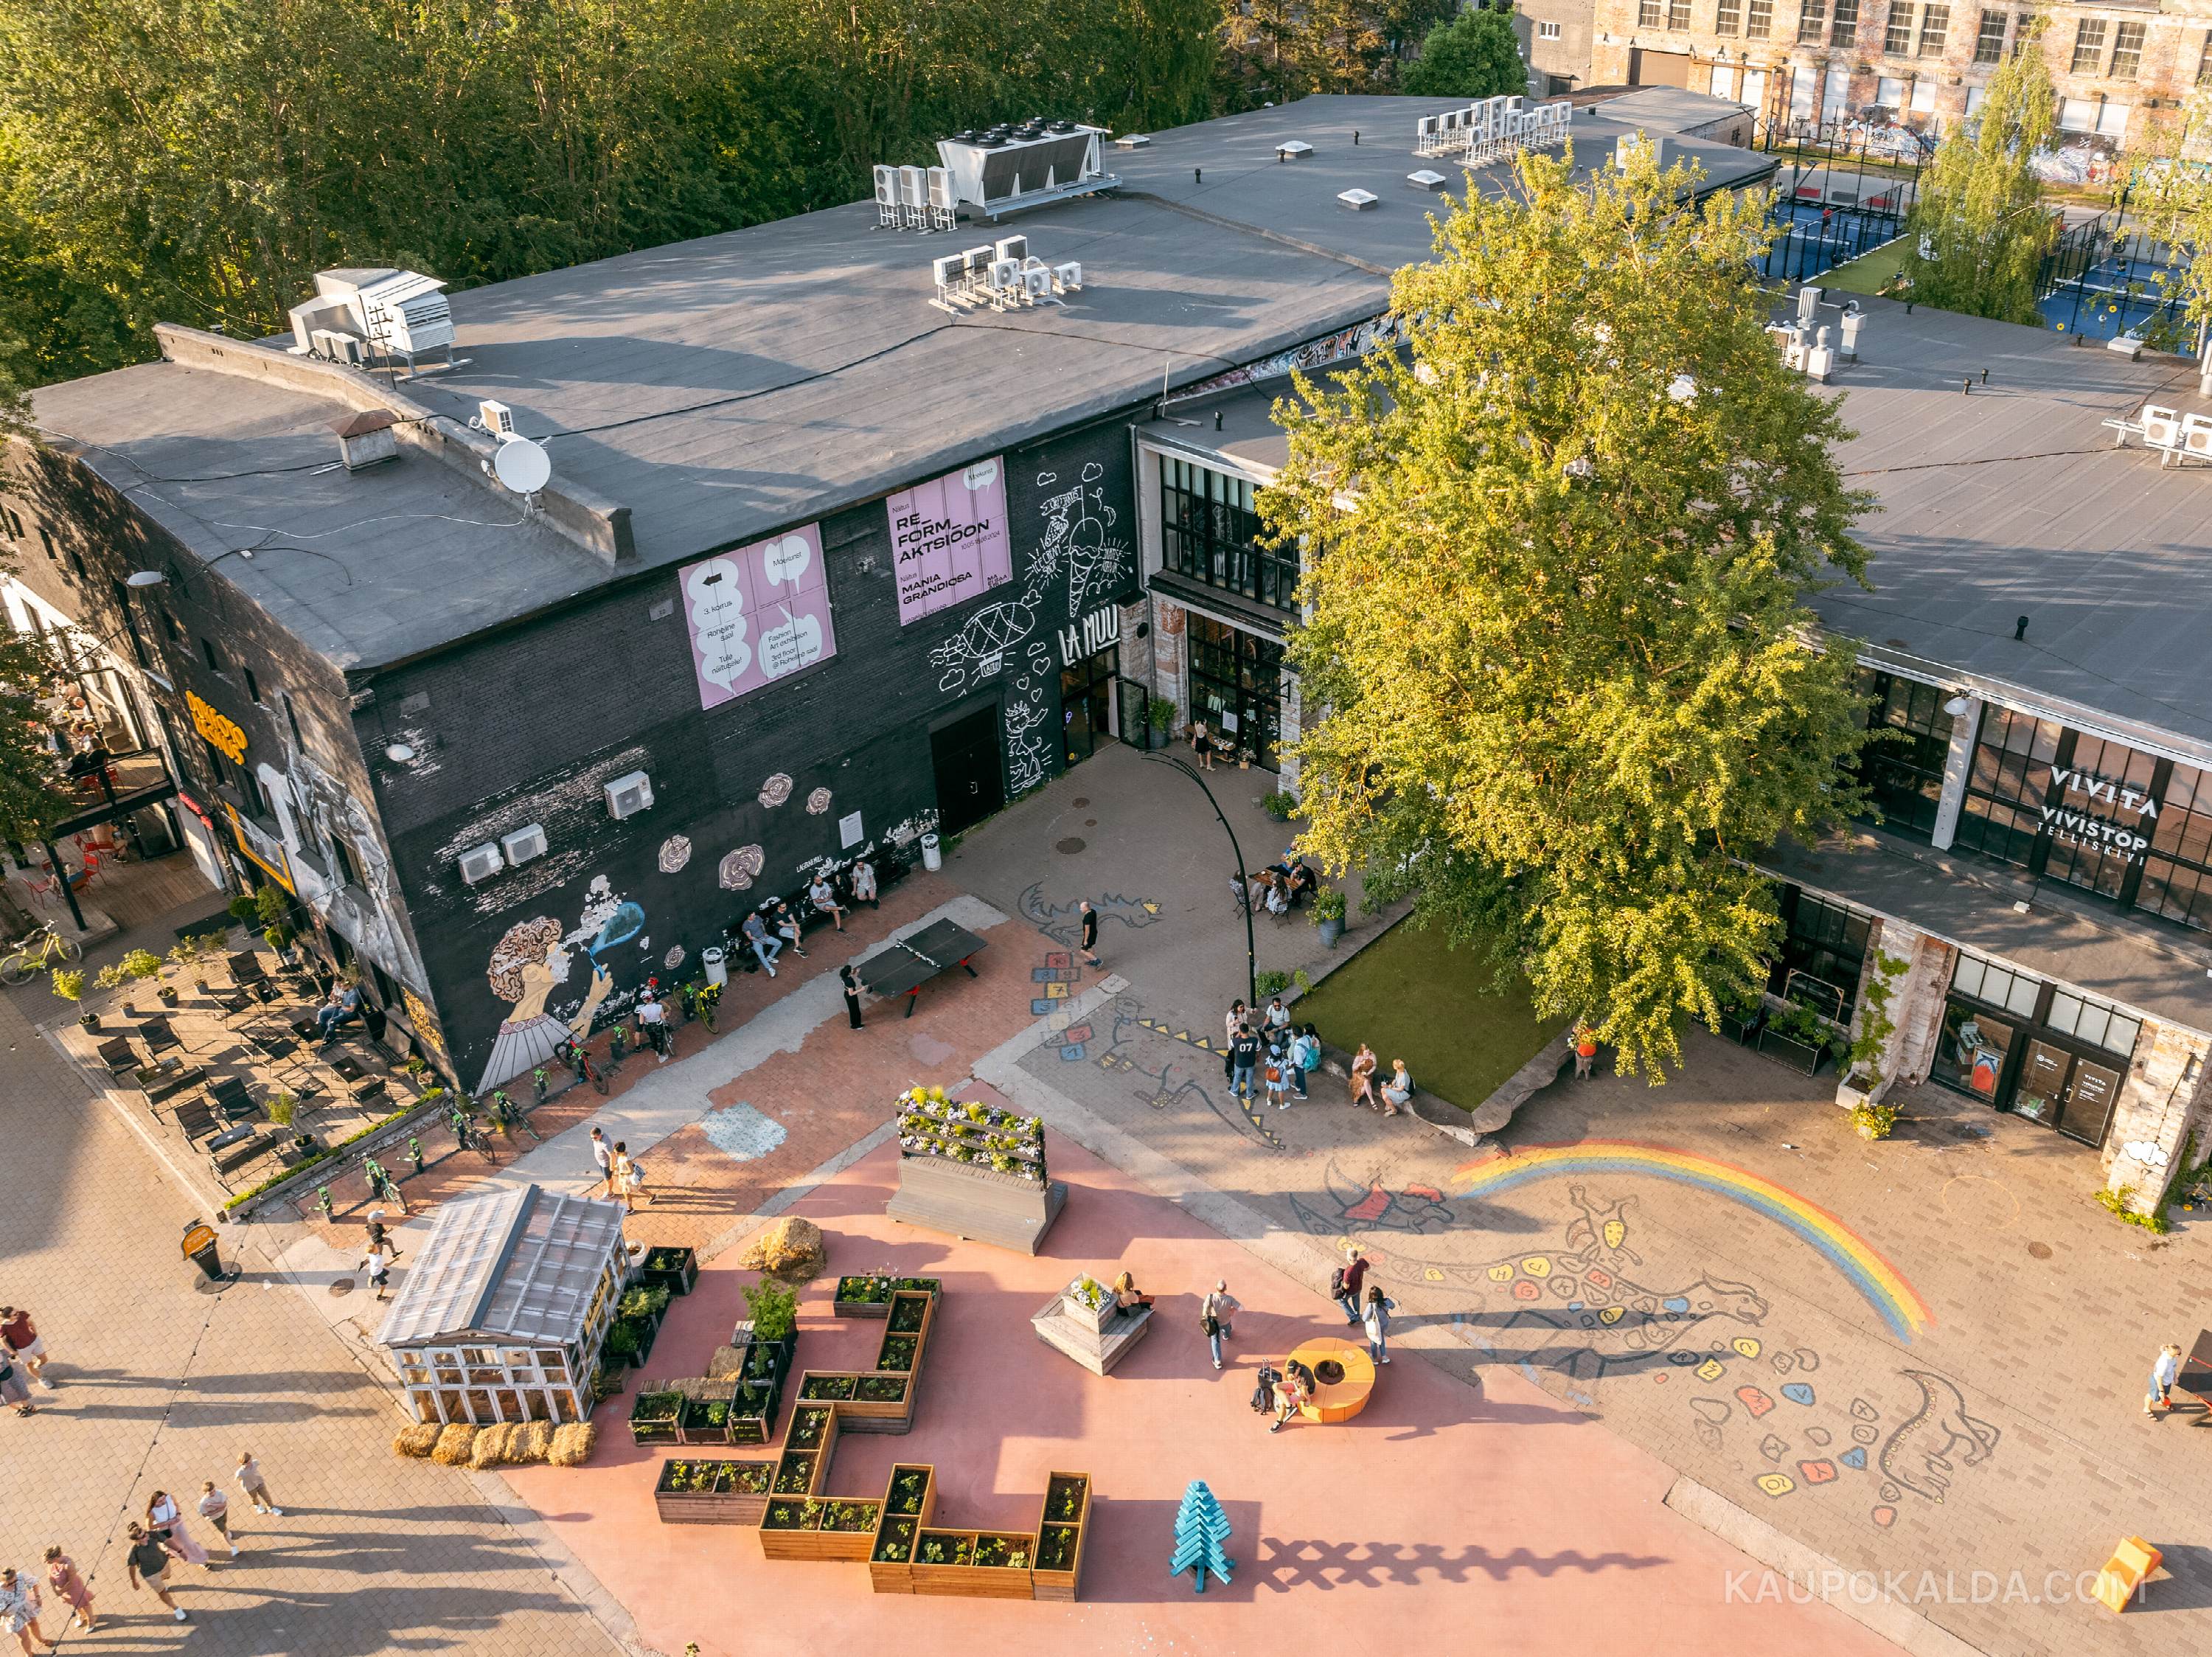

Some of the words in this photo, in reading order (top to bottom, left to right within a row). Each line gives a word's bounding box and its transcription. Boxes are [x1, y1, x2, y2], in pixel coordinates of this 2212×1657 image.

[773, 551, 802, 567] Moekunst
[902, 574, 942, 594] MANIA
[902, 572, 973, 605] GRANDIOSA
[711, 600, 733, 612] korrus
[707, 622, 736, 639] Roheline
[720, 631, 734, 642] saal
[768, 629, 792, 643] Fashion
[1058, 625, 1082, 666] LA
[1082, 603, 1119, 656] MUU
[770, 641, 779, 650] Art
[779, 631, 808, 647] exhibition
[771, 652, 782, 661] 3rd
[782, 647, 796, 658] floor
[805, 645, 818, 656] saal
[718, 653, 733, 663] Tule
[2051, 765, 2157, 819] VIVITA
[2041, 805, 2148, 851] VIVISTOP
[2037, 821, 2144, 866] TELLISKIVI
[1239, 1043, 1253, 1052] 07
[1428, 1269, 1436, 1280] F
[1495, 1270, 1507, 1280] H
[1814, 1465, 1828, 1479] Y
